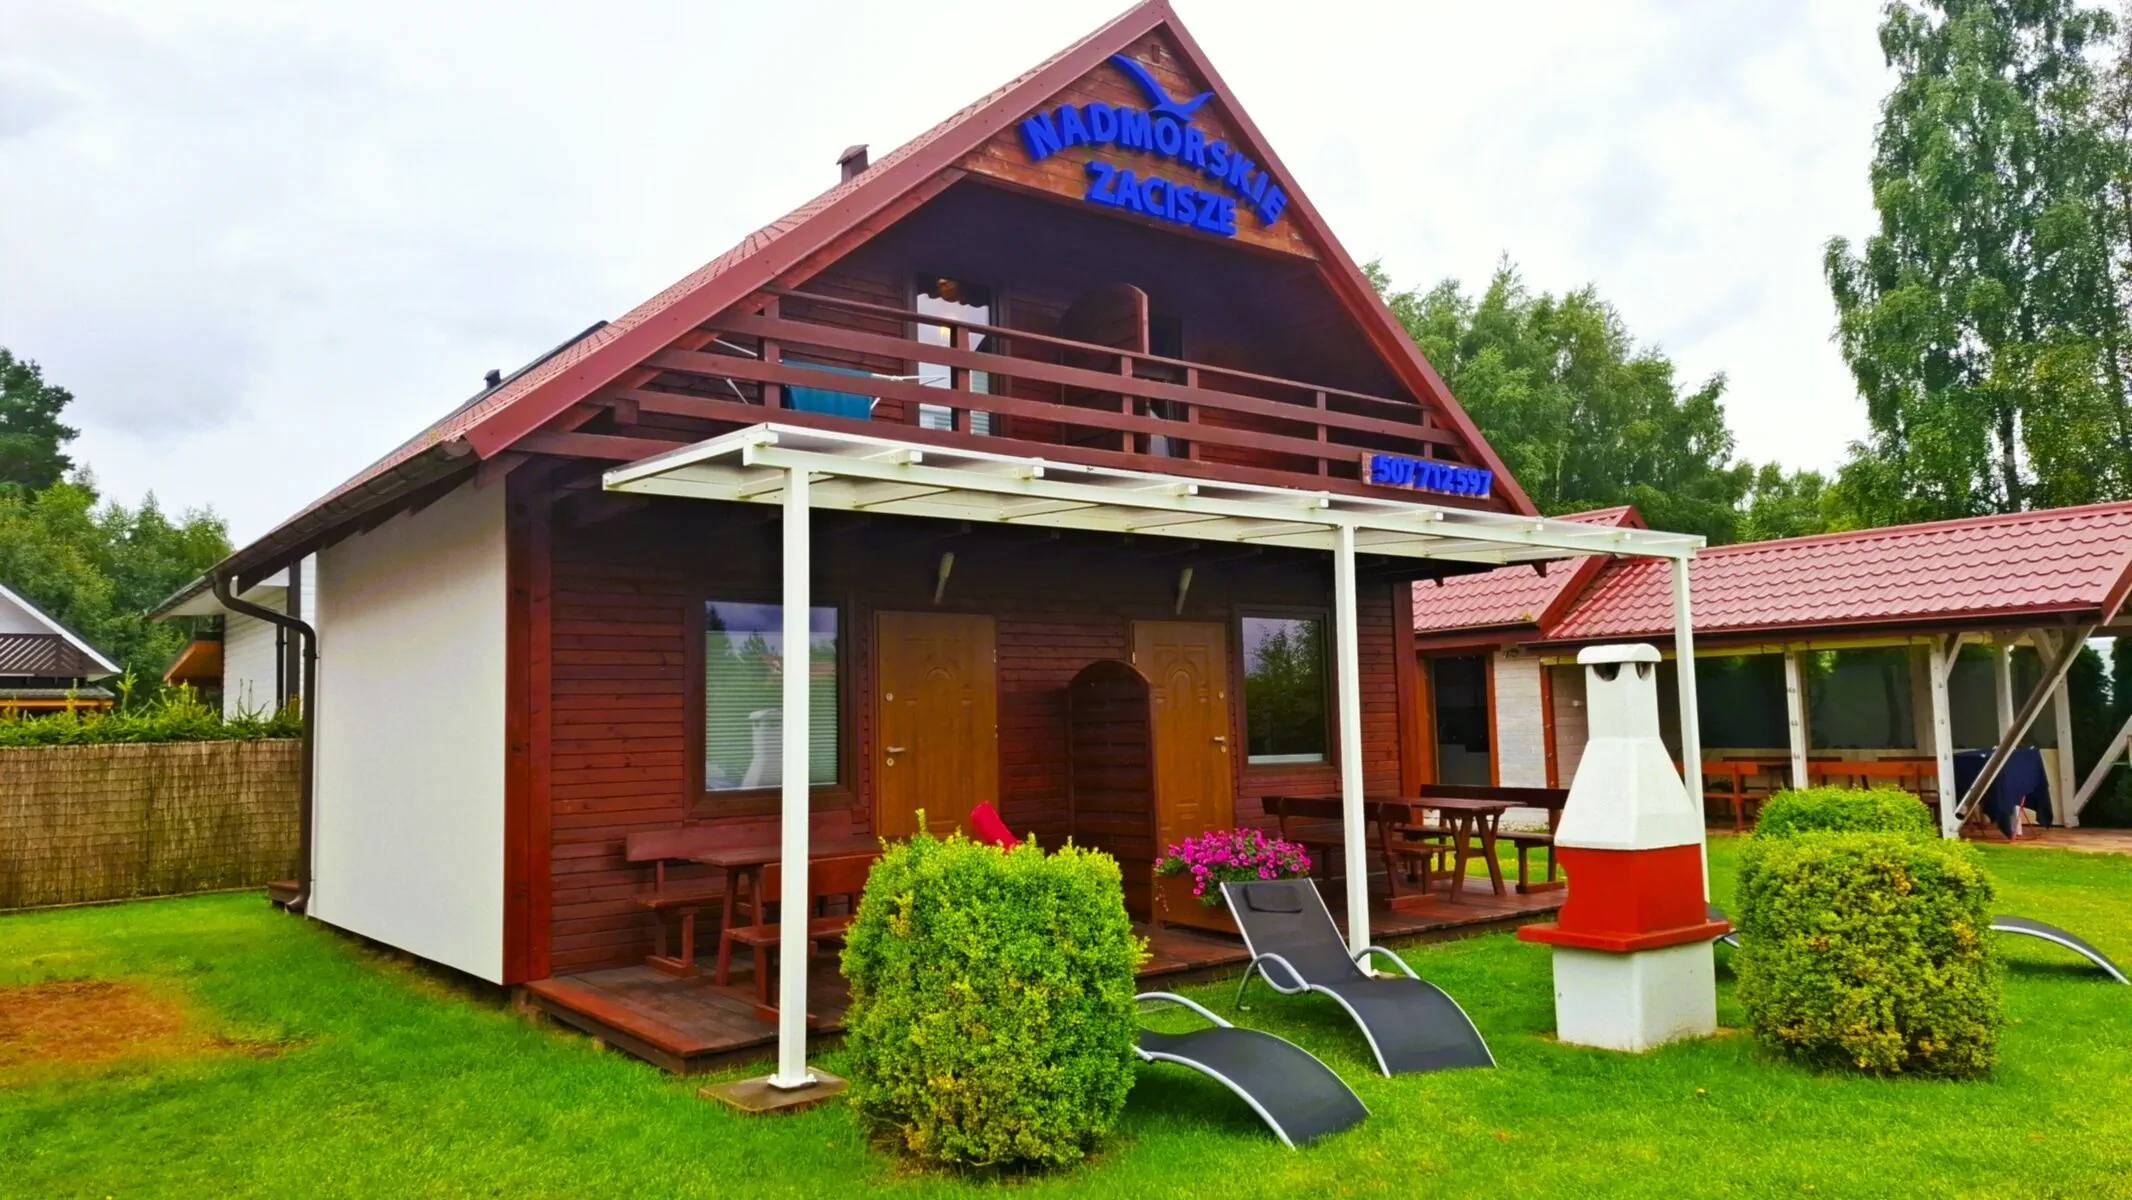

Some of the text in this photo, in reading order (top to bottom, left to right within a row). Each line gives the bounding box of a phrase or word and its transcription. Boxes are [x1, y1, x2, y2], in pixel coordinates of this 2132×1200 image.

[1021, 101, 1288, 228] NADMORSKIE
[1084, 160, 1237, 237] ZACISZE
[1371, 454, 1493, 496] 507 712 597
